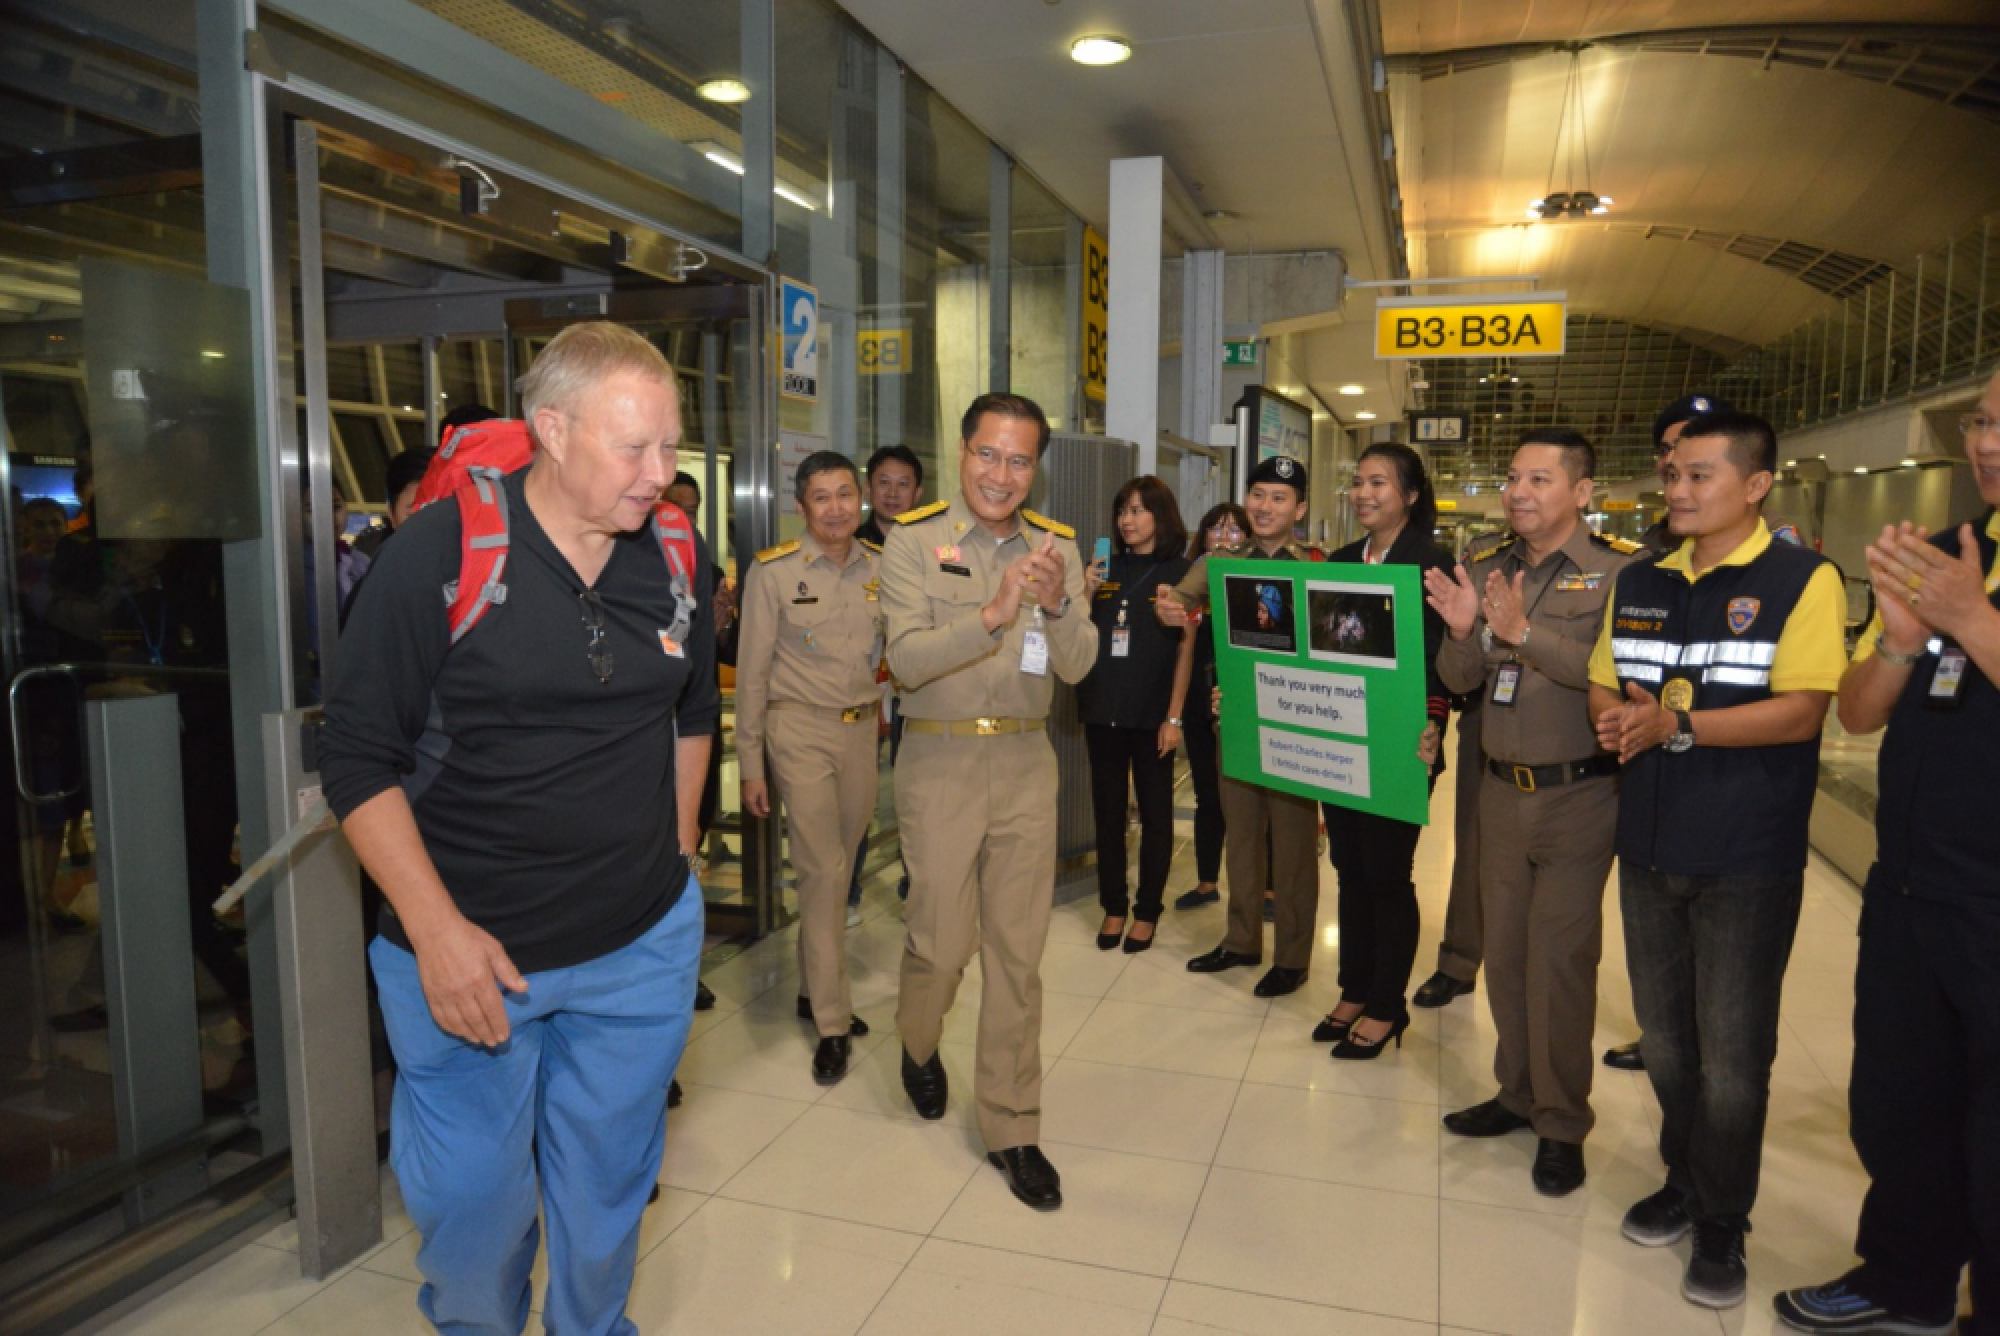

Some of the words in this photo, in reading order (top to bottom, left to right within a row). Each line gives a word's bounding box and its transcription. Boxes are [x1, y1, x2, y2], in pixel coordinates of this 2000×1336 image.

[792, 297, 817, 373] 2
[1258, 672, 1286, 688] Thank
[1288, 680, 1306, 692] you
[1308, 684, 1332, 698] very
[1334, 685, 1365, 699] much
[1278, 696, 1292, 710] for
[1294, 703, 1314, 715] you
[1316, 702, 1342, 722] help.
[1268, 738, 1293, 752] Robert
[1293, 744, 1323, 759] Charles
[1325, 750, 1354, 765] Harper
